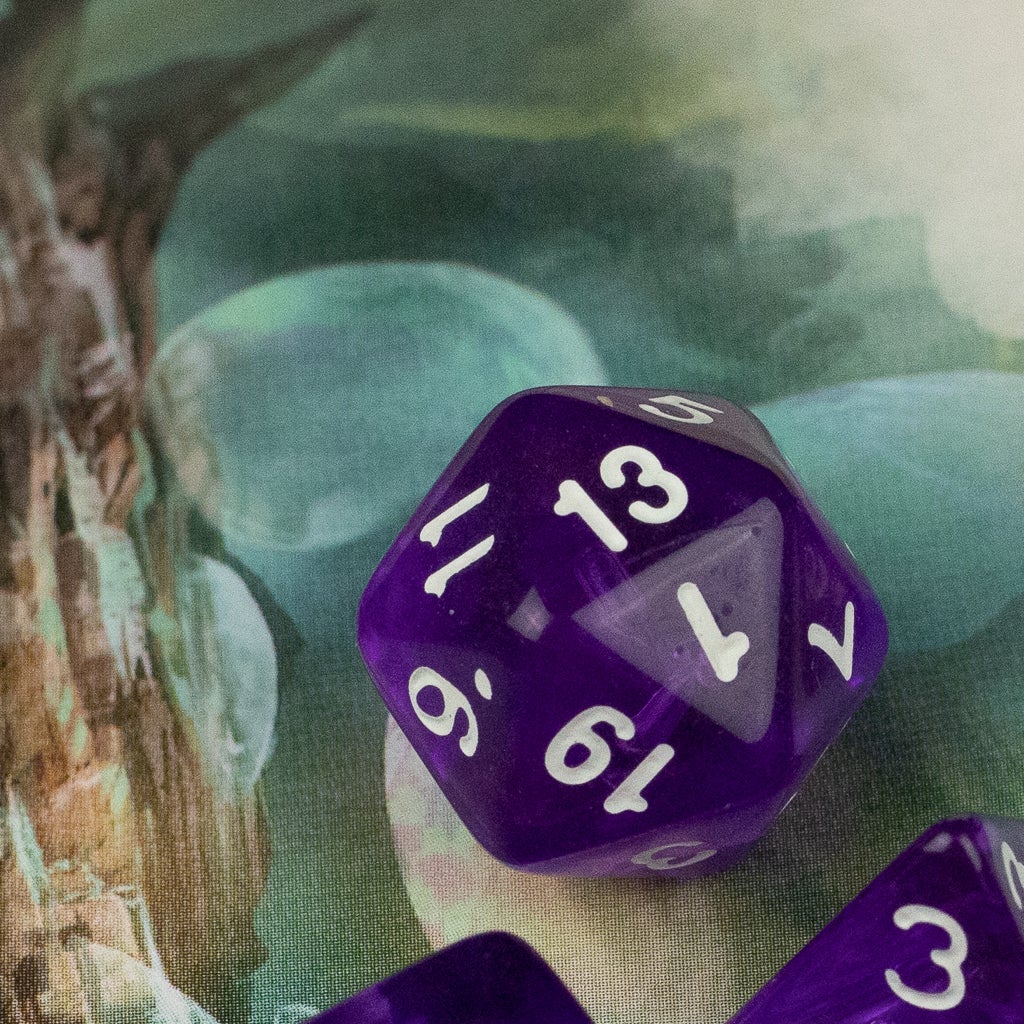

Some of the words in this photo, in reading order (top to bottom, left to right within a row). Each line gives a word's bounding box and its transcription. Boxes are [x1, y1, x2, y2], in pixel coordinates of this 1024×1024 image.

[419, 482, 495, 598] 11
[553, 444, 689, 552] 13
[677, 582, 750, 682] 1
[544, 705, 675, 815] 19
[884, 904, 968, 1011] 3
